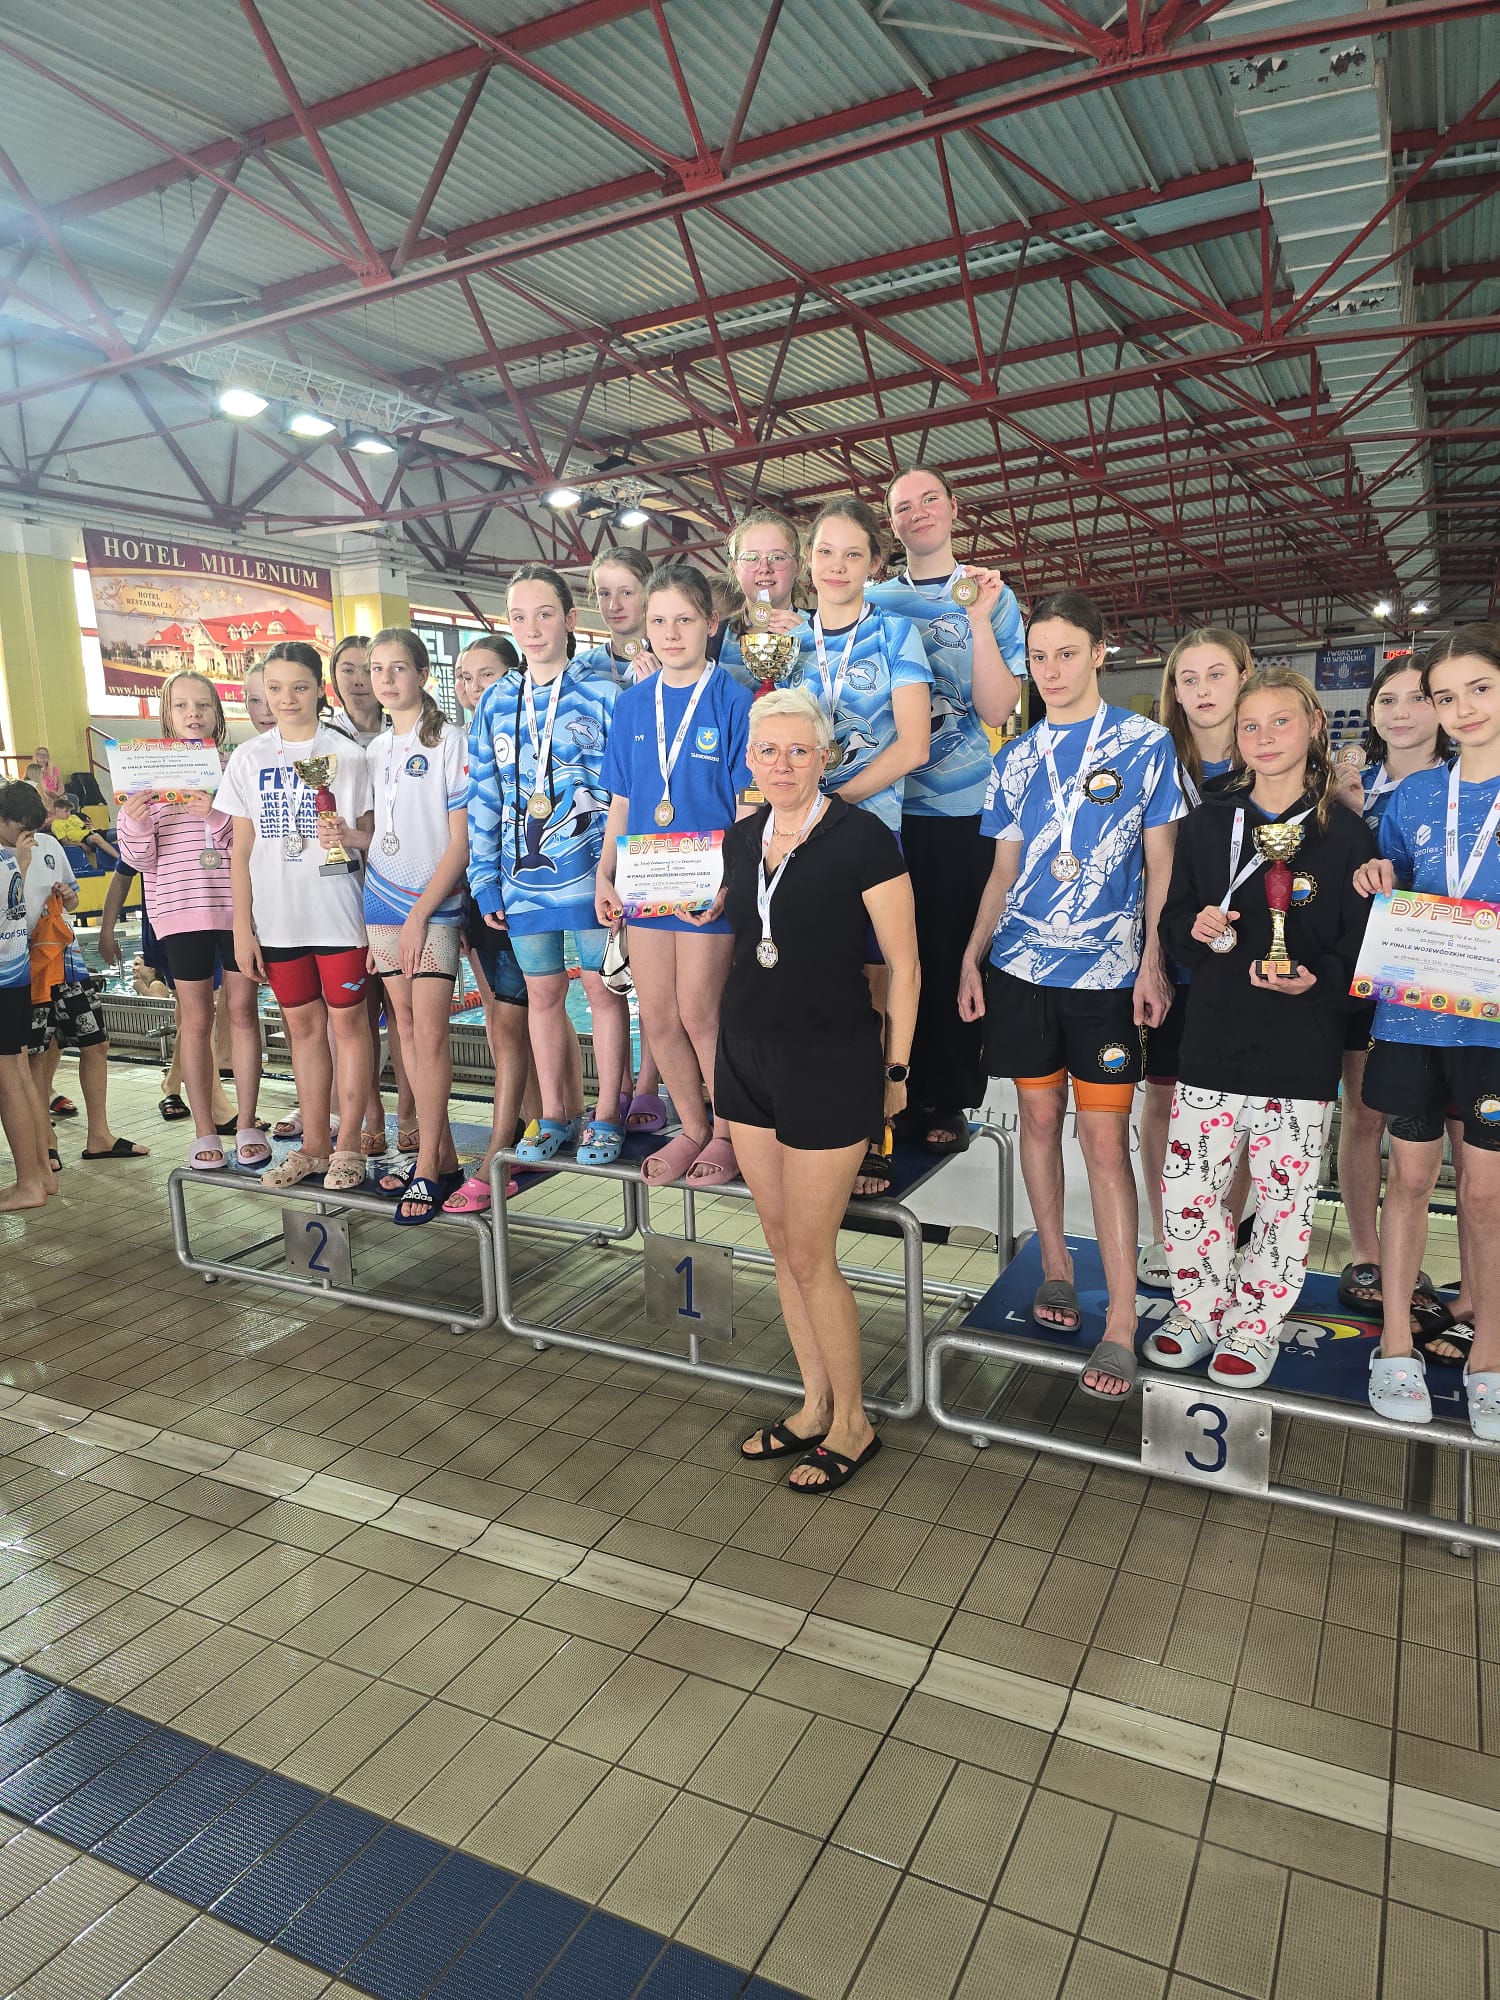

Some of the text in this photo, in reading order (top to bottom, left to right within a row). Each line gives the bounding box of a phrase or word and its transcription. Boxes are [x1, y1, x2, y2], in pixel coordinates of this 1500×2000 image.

[103, 536, 319, 589] HOTEL MILLENIUM
[126, 598, 173, 609] RESTAURACJA
[138, 591, 160, 601] HOTEL
[119, 742, 203, 752] DYPLOM
[260, 810, 280, 818] LIKE
[281, 809, 290, 817] A
[629, 837, 711, 856] DYPLOM
[1391, 898, 1500, 931] DYPLO
[1389, 941, 1412, 950] FINALE
[1413, 944, 1465, 958] WOJEWÓDZKIM
[1466, 954, 1495, 964] IGRZYSK
[1287, 1116, 1301, 1142] Hello
[1197, 1133, 1209, 1182] Hello Kitty
[306, 1221, 330, 1273] 2
[1267, 1222, 1279, 1269] Hello Kitty
[675, 1256, 701, 1319] 1
[1185, 1403, 1228, 1473] 3
